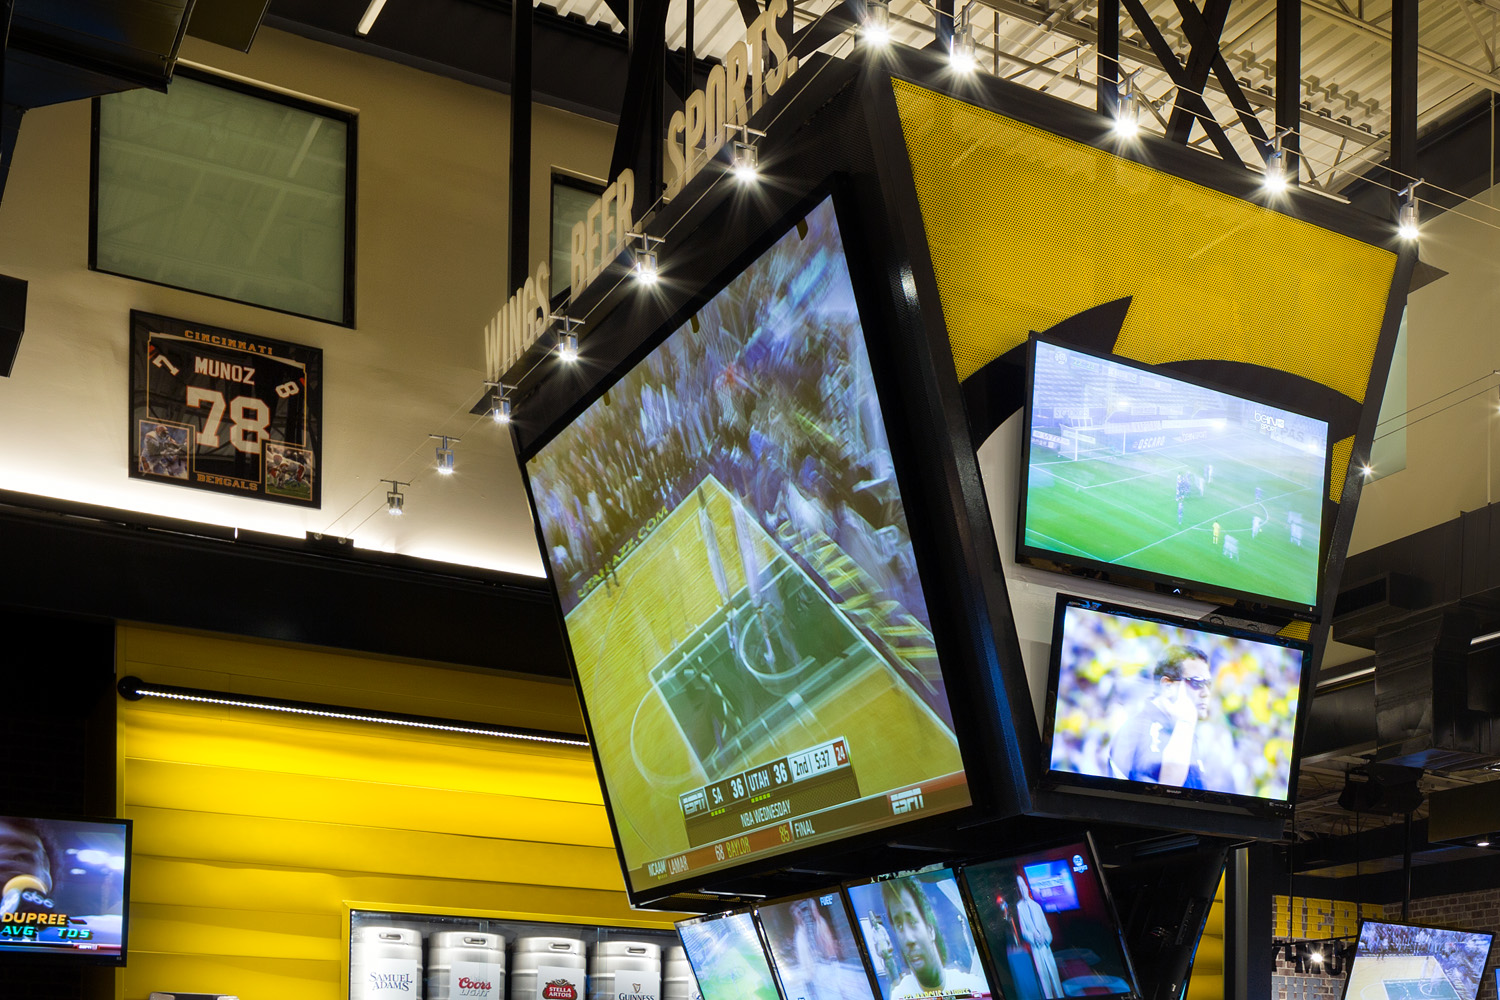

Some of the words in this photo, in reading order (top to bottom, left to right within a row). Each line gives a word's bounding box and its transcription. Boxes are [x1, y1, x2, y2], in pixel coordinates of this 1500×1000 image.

[185, 330, 273, 355] CINCINNATI
[195, 356, 255, 385] MUNOZ
[186, 386, 270, 454] 78
[197, 473, 258, 491] BENGALS
[682, 792, 706, 815] ESPN
[712, 787, 724, 804] SA
[731, 778, 745, 799] 36
[748, 769, 770, 791] UTAH
[773, 762, 788, 784] 36
[794, 757, 808, 776] 2nd
[814, 750, 830, 770] 5:37
[836, 745, 846, 761] 24
[890, 788, 924, 815] ESPN
[740, 812, 755, 828] NBA
[754, 800, 792, 823] WEDNESDAY
[668, 856, 689, 875] LAMAR
[714, 845, 725, 861] 68
[726, 837, 751, 858] BAYLOR
[779, 825, 790, 842] 85
[794, 819, 815, 838] FINAL
[2, 912, 67, 925] DUPREE
[58, 928, 90, 938] TDS
[369, 972, 413, 983] SAMUEL
[372, 980, 410, 992] ADAMS
[458, 977, 492, 990] Coors
[460, 989, 490, 997] LIGHT
